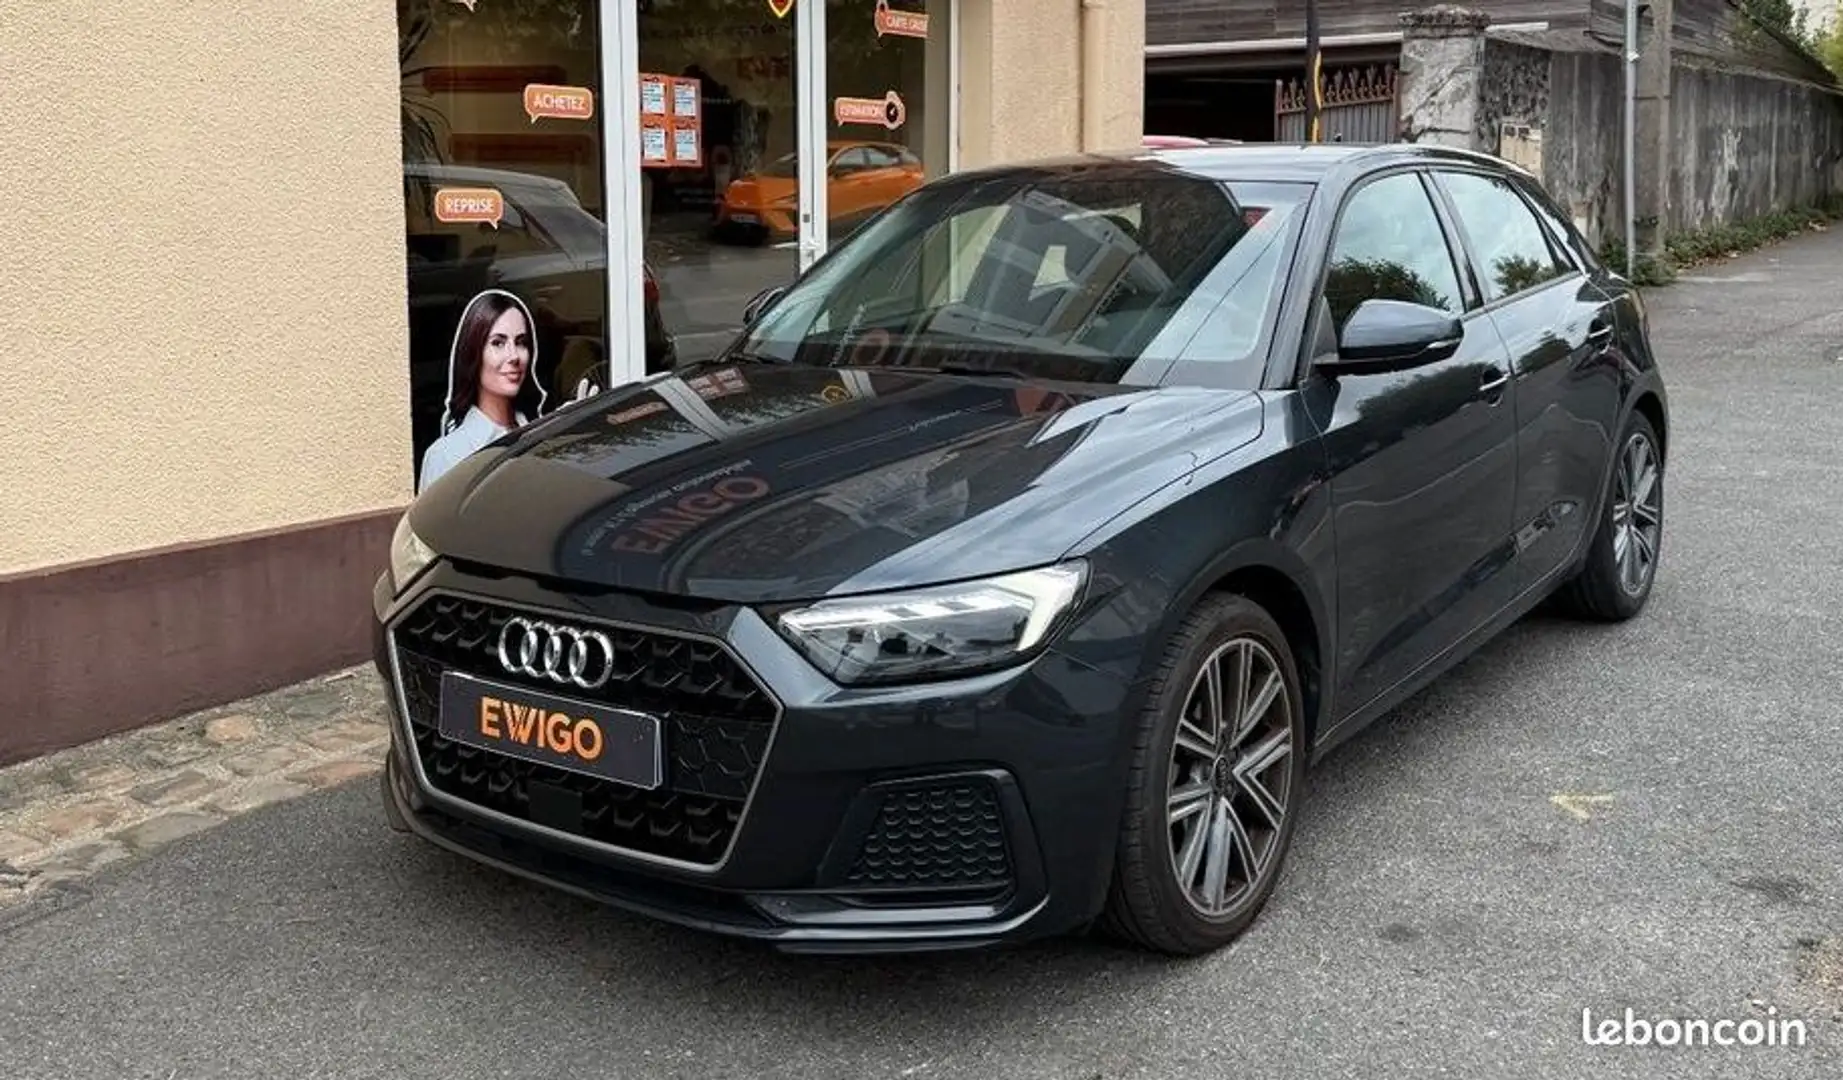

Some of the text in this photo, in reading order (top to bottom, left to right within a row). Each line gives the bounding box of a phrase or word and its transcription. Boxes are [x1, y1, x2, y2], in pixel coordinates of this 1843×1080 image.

[533, 94, 586, 110] ACHETEZ
[444, 198, 495, 213] REPRISE
[479, 697, 602, 761] EWIGO
